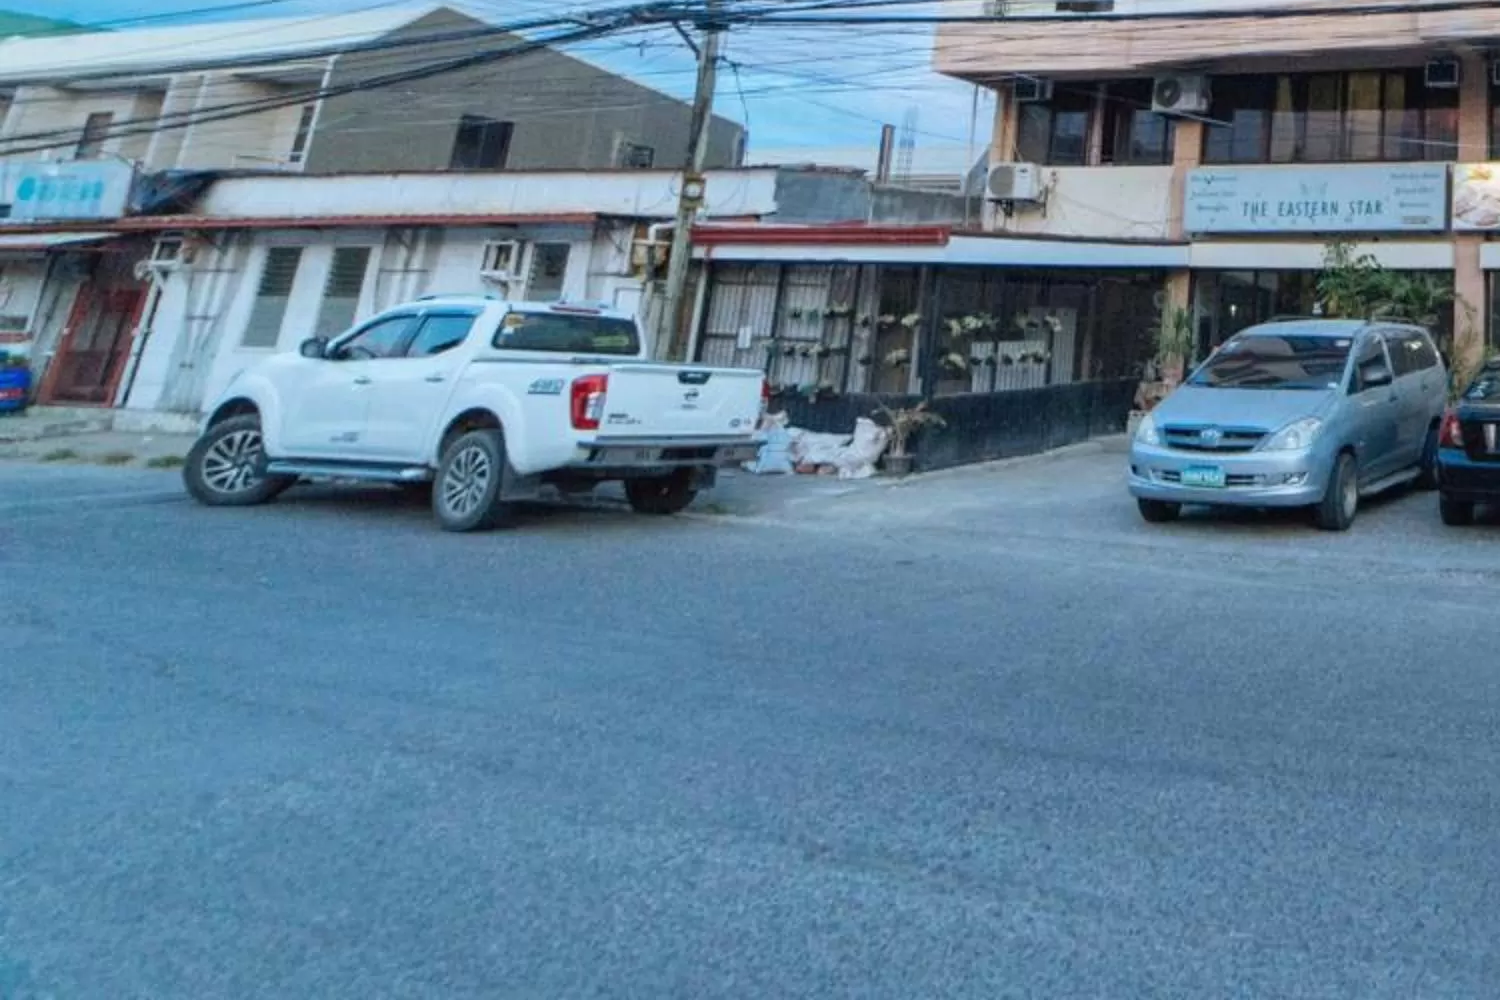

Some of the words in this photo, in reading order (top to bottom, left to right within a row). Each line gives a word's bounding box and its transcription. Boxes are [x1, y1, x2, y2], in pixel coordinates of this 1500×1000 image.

[1242, 200, 1267, 217] THE
[1278, 200, 1340, 217] EASTERN
[1349, 200, 1384, 217] STAR
